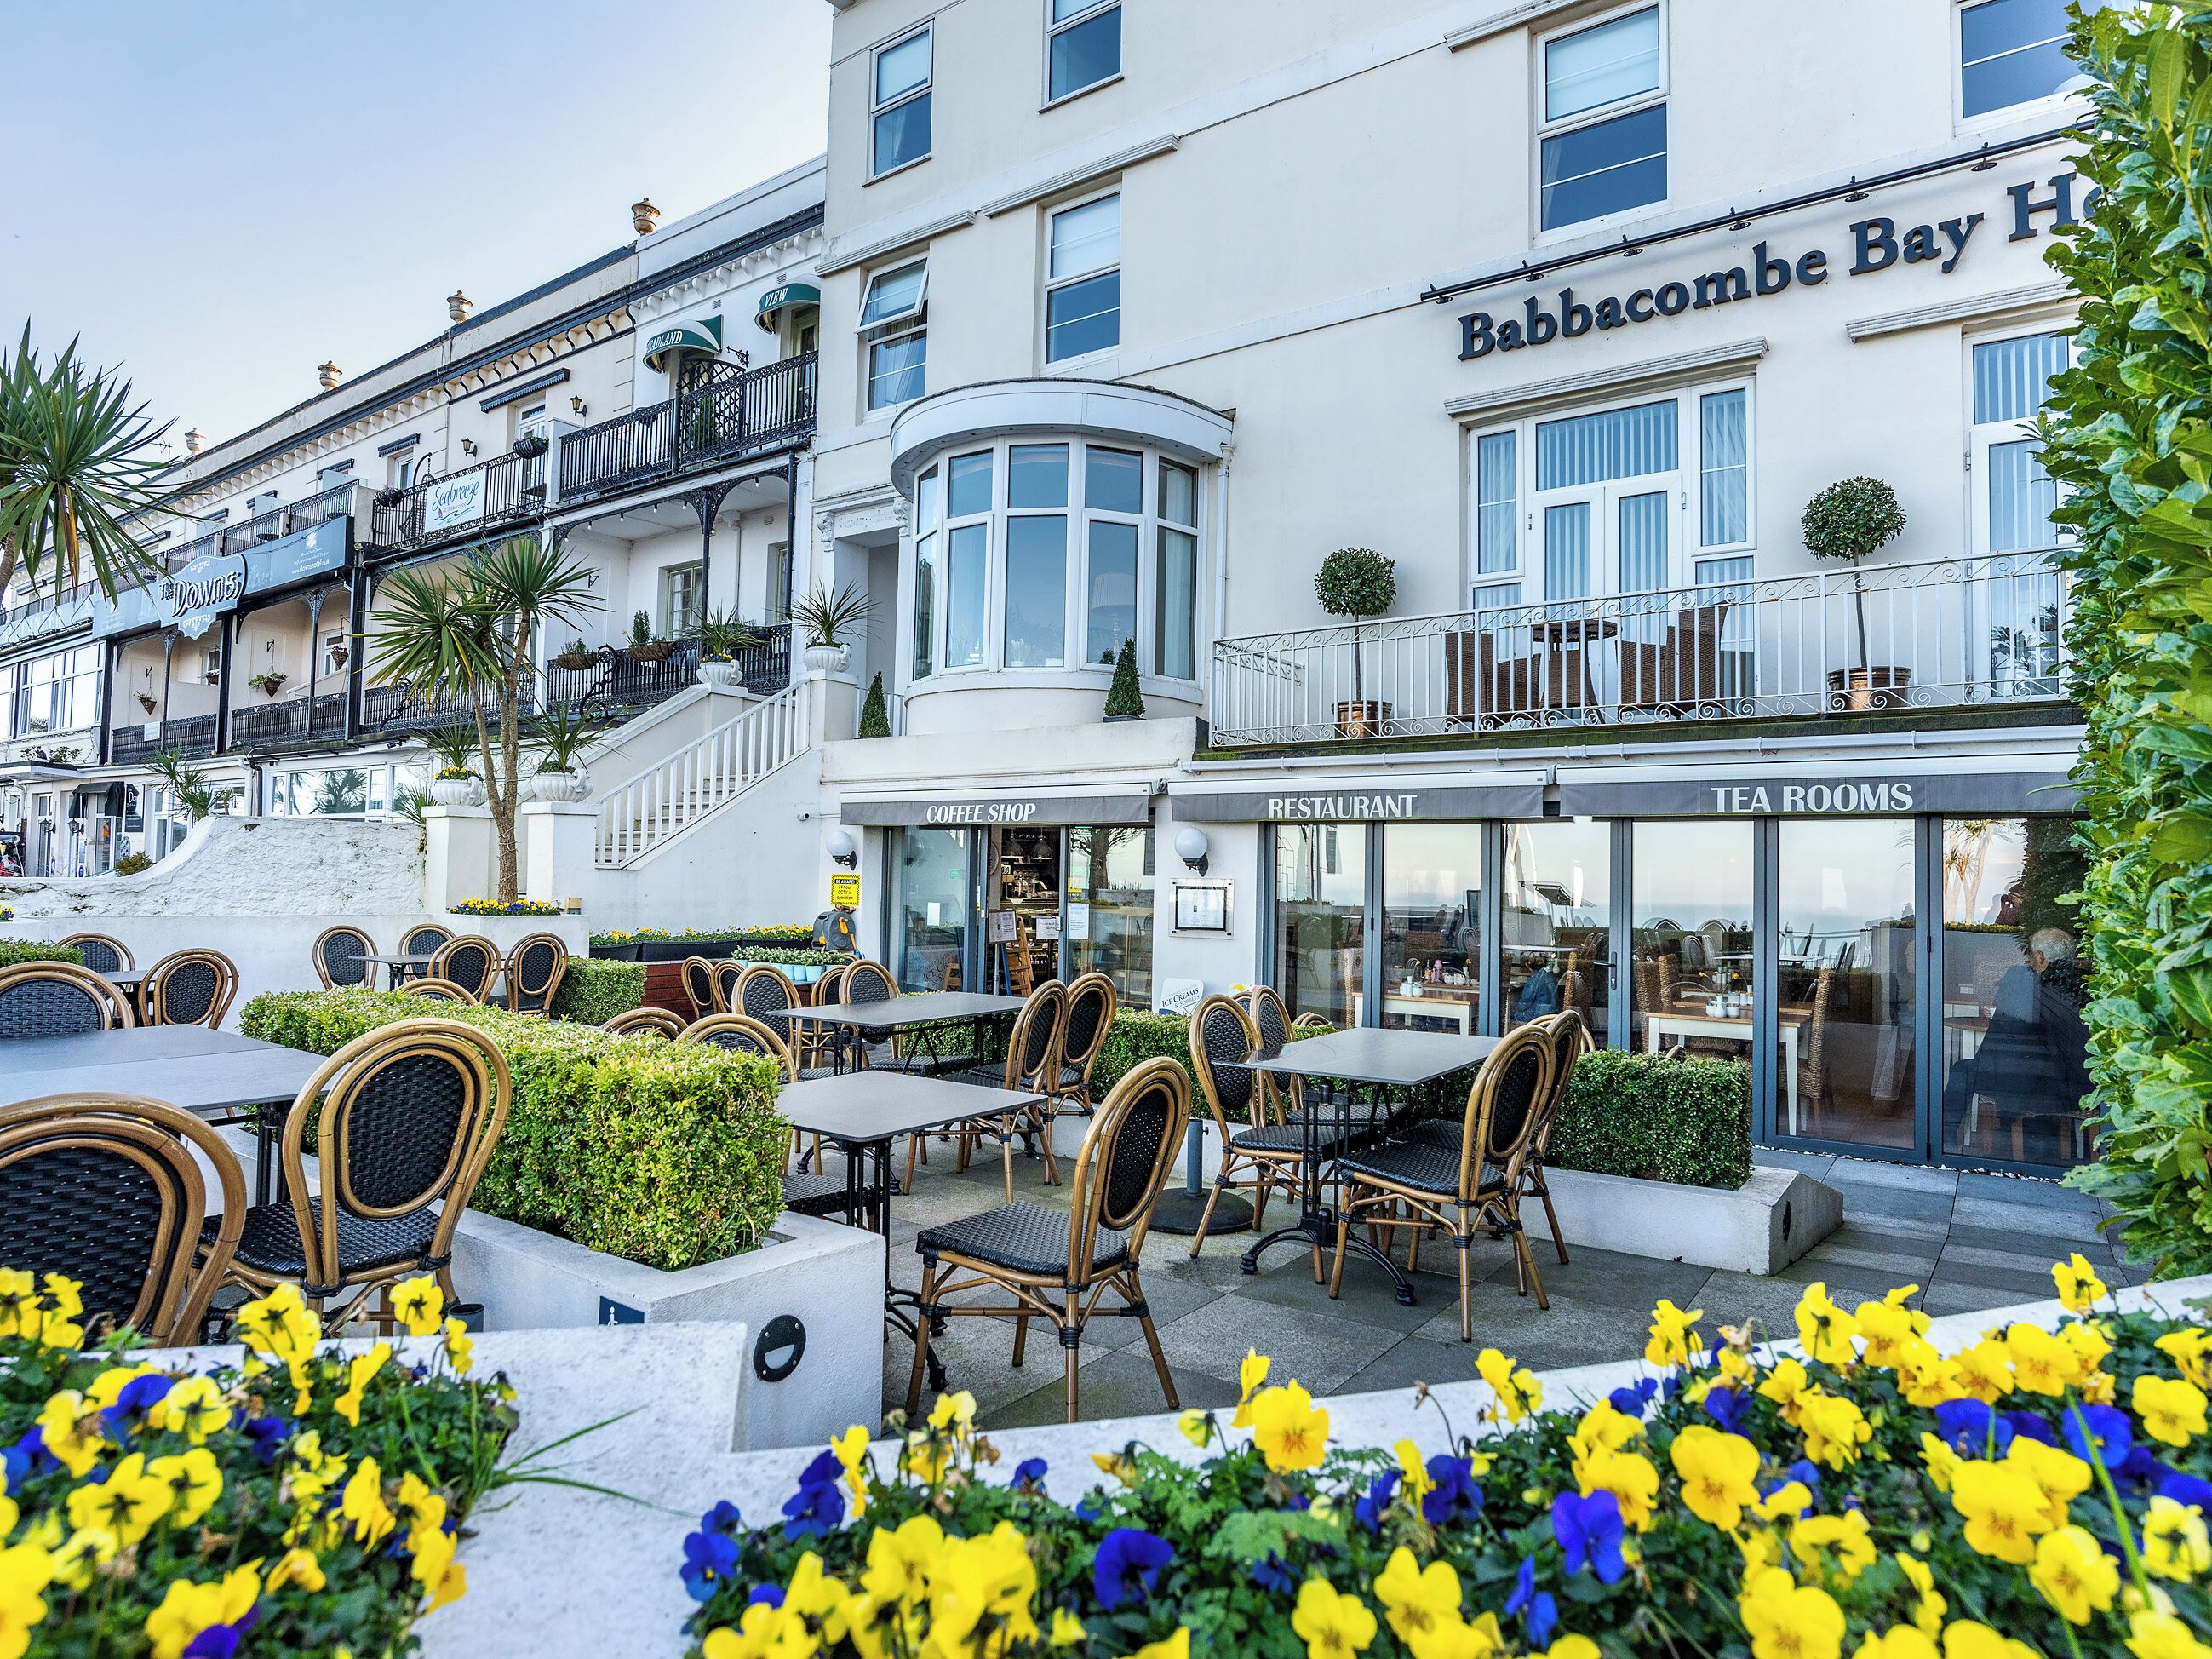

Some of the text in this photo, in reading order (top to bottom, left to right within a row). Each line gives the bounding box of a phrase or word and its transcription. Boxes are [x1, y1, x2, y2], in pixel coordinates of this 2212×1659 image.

[764, 287, 788, 308] VIEW
[1458, 241, 1828, 361] Babbacombe
[1849, 212, 1985, 277] Bay
[647, 330, 683, 353] EADLAND
[432, 481, 479, 511] Seabreeze
[159, 582, 175, 600] The
[1268, 795, 1418, 819] RESTAURANT
[1711, 783, 1914, 812] TEA ROOMS
[926, 803, 1036, 824] COFFEE SHOP
[1162, 998, 1172, 1007] ICE
[1173, 988, 1199, 1002] CREAMS
